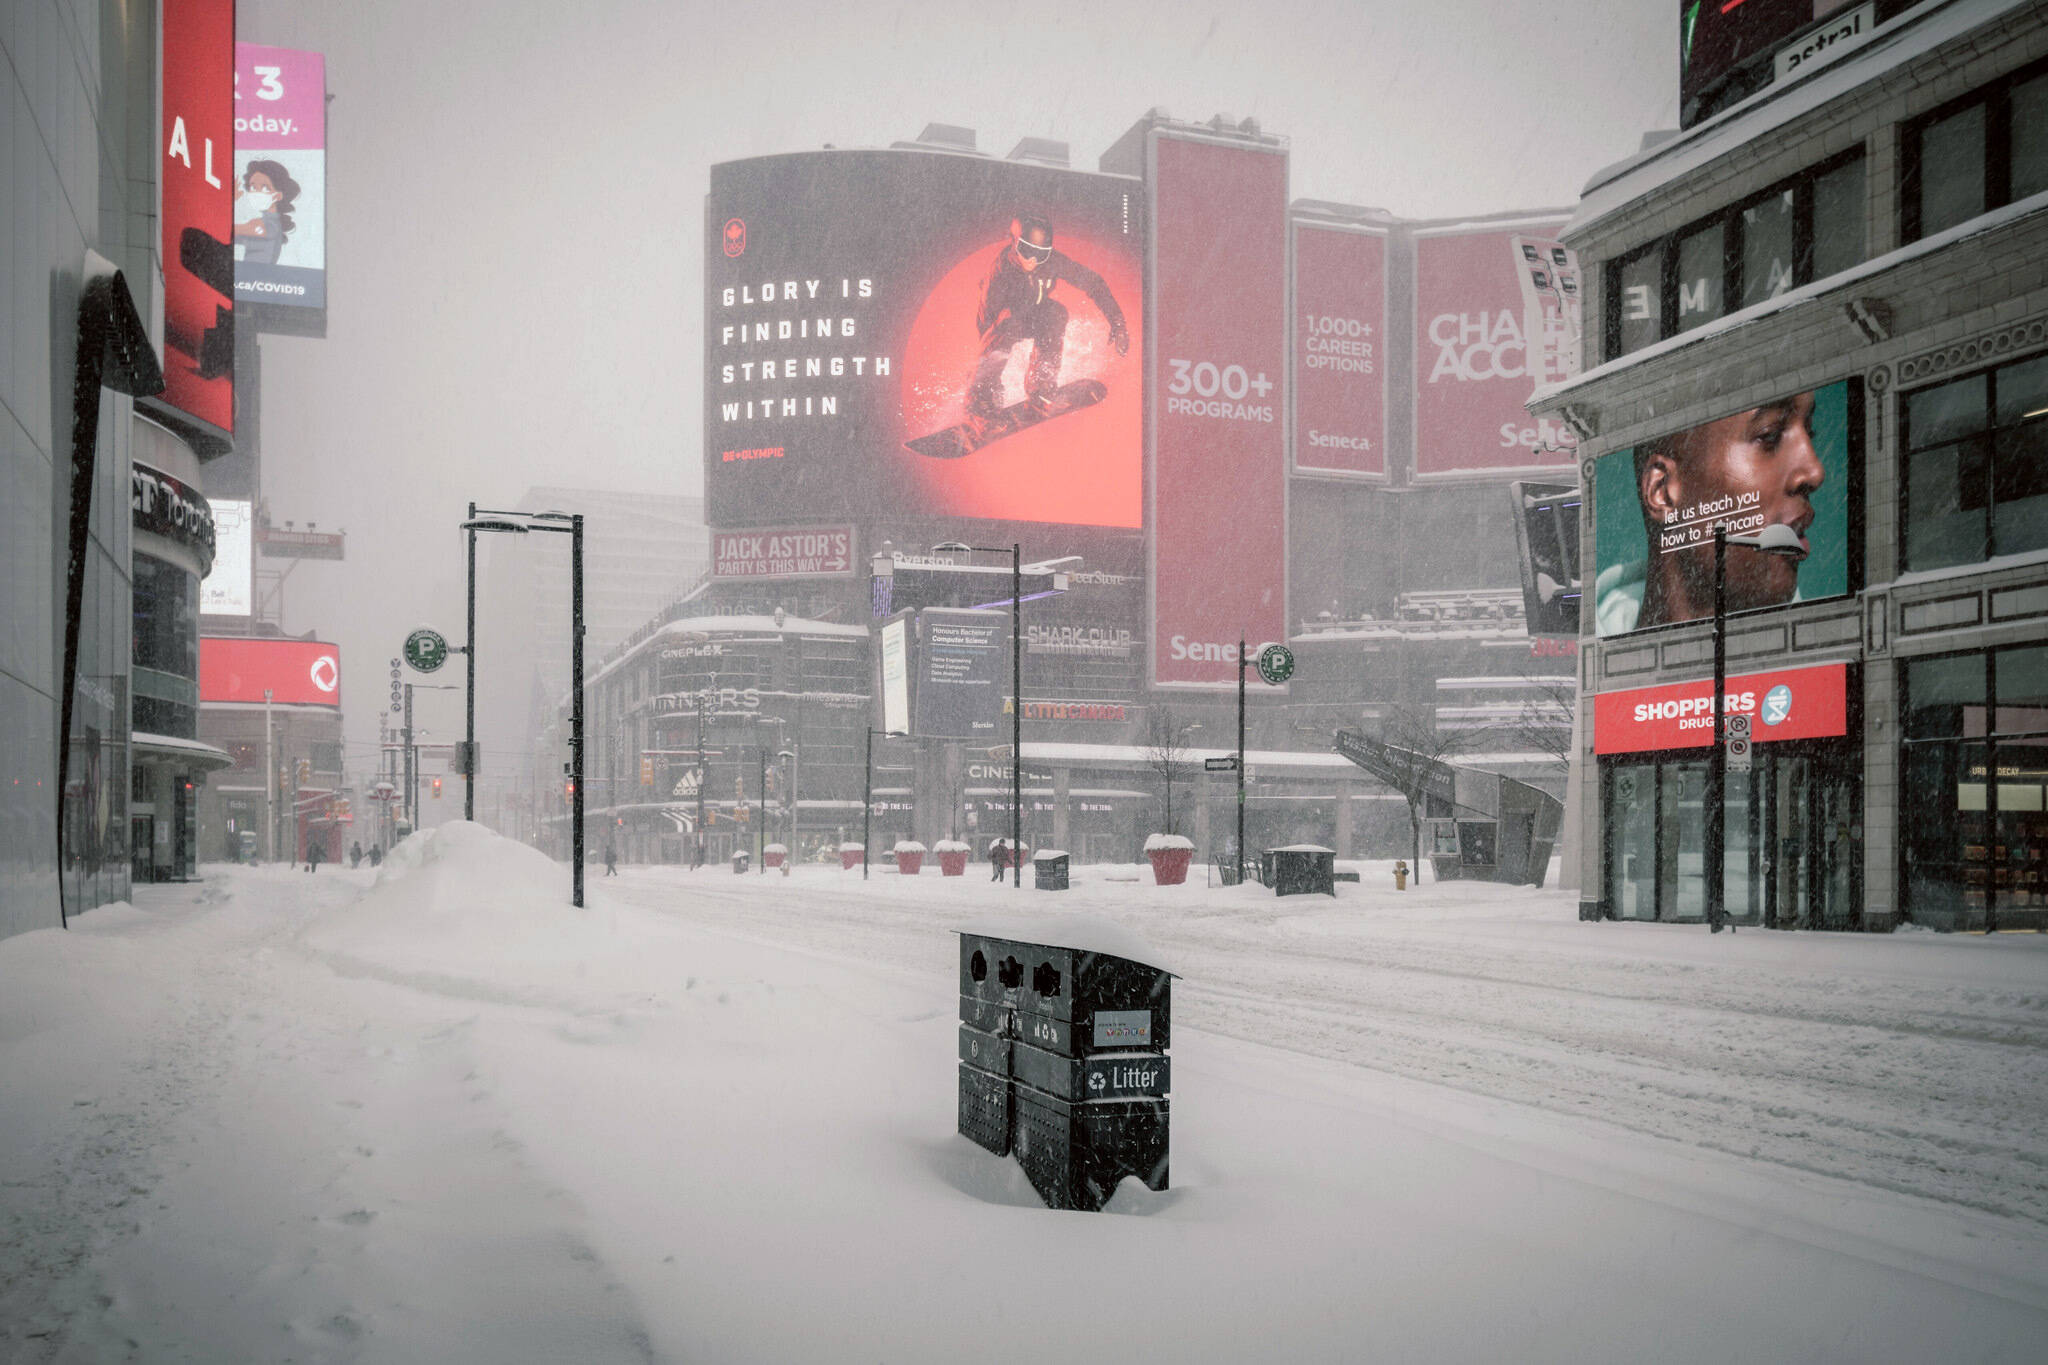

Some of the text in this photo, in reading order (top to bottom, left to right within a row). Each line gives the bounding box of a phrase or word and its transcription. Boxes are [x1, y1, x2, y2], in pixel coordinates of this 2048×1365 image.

[253, 66, 285, 102] 3
[723, 278, 873, 307] GLORY IS
[723, 318, 856, 345] FINDING
[1306, 314, 1373, 338] 1,000+
[1428, 308, 1530, 347] CHA
[1306, 336, 1373, 358] CAREER
[722, 357, 891, 384] STRENGTH
[1306, 353, 1373, 374] OPTIONS
[1168, 358, 1273, 400] 300+
[722, 397, 837, 422] WITHIN
[1167, 397, 1274, 423] PROGRAMS
[1308, 429, 1370, 451] Seneca
[1664, 490, 1760, 524] let us teach you
[1660, 513, 1764, 548] how to #incare
[718, 534, 847, 560] JACK ASTOR'S
[717, 558, 823, 575] PARTY IS THIS WAY
[418, 638, 435, 656] P
[1027, 625, 1130, 648] SHARK CLUB
[1272, 654, 1286, 670] P
[1634, 692, 1756, 722] SHOPPRS
[672, 786, 698, 796] adida
[1113, 1066, 1159, 1089] Litter
